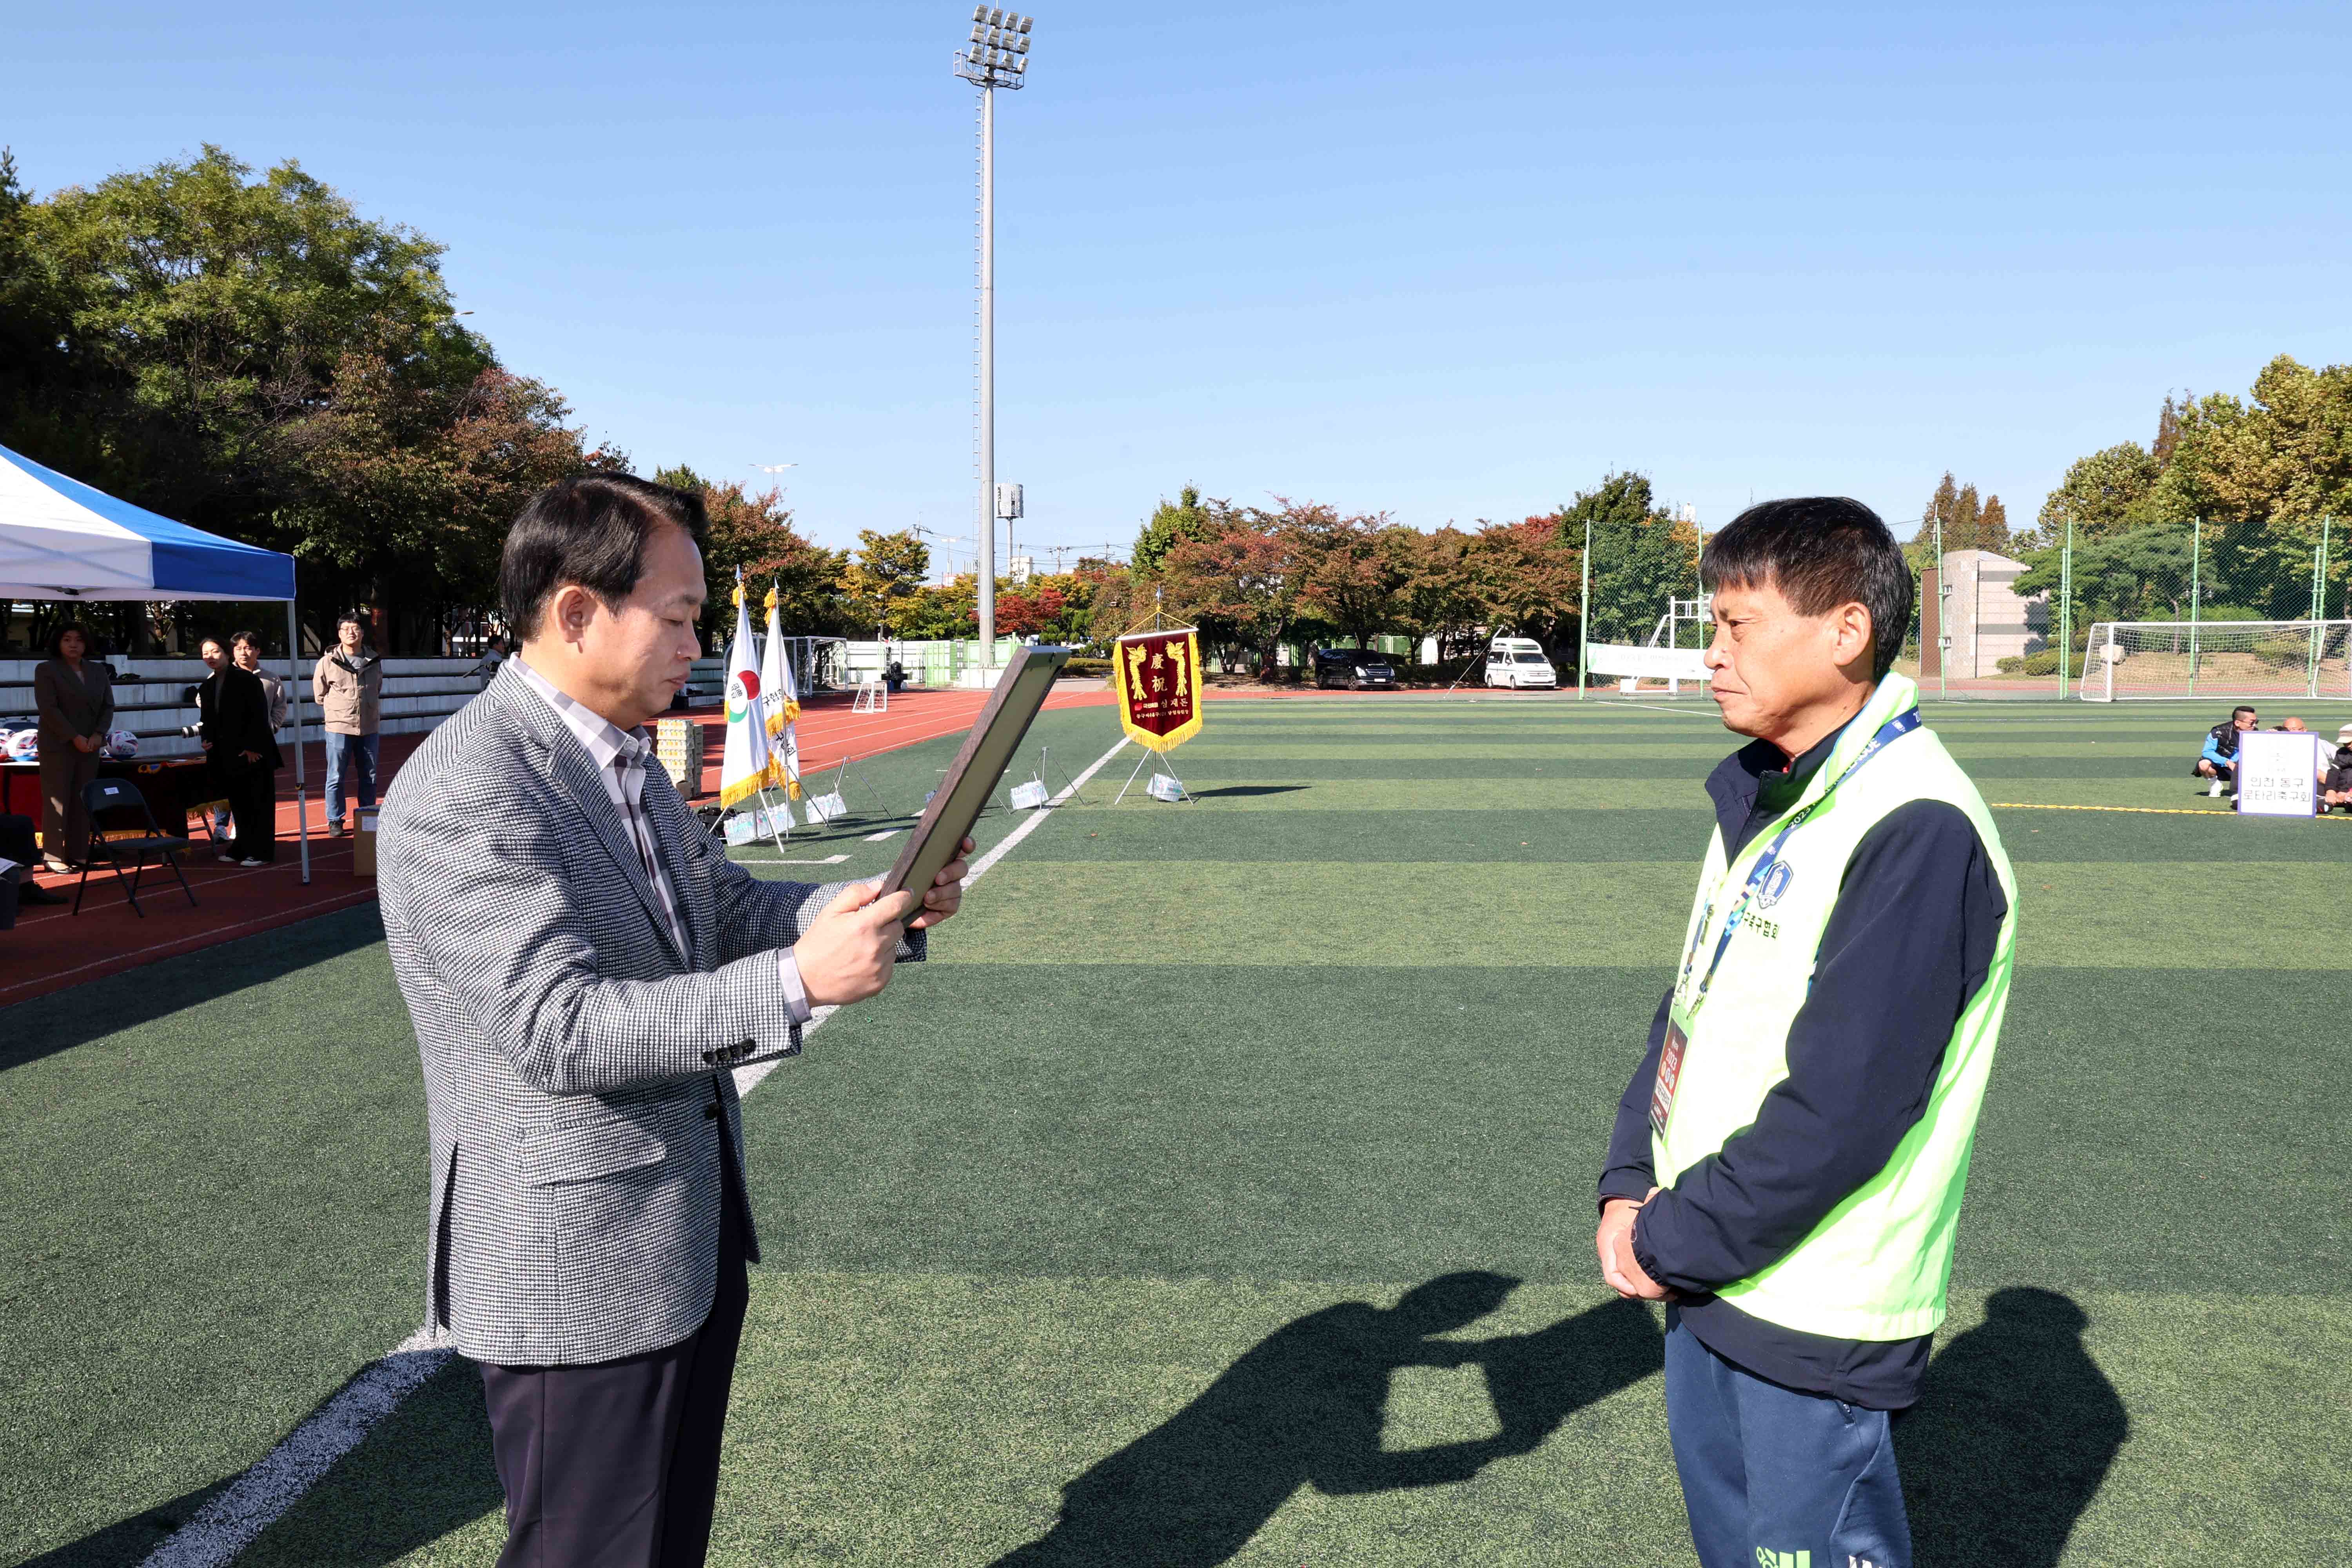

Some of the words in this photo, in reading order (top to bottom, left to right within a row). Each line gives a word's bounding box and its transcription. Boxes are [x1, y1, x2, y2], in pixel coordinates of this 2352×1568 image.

[1151, 653, 1168, 693] 慶祝
[2250, 776, 2274, 787] 인천
[2280, 778, 2303, 789] 동구
[1744, 912, 1780, 940] 구축구협회
[1666, 1047, 1678, 1071] 2023
